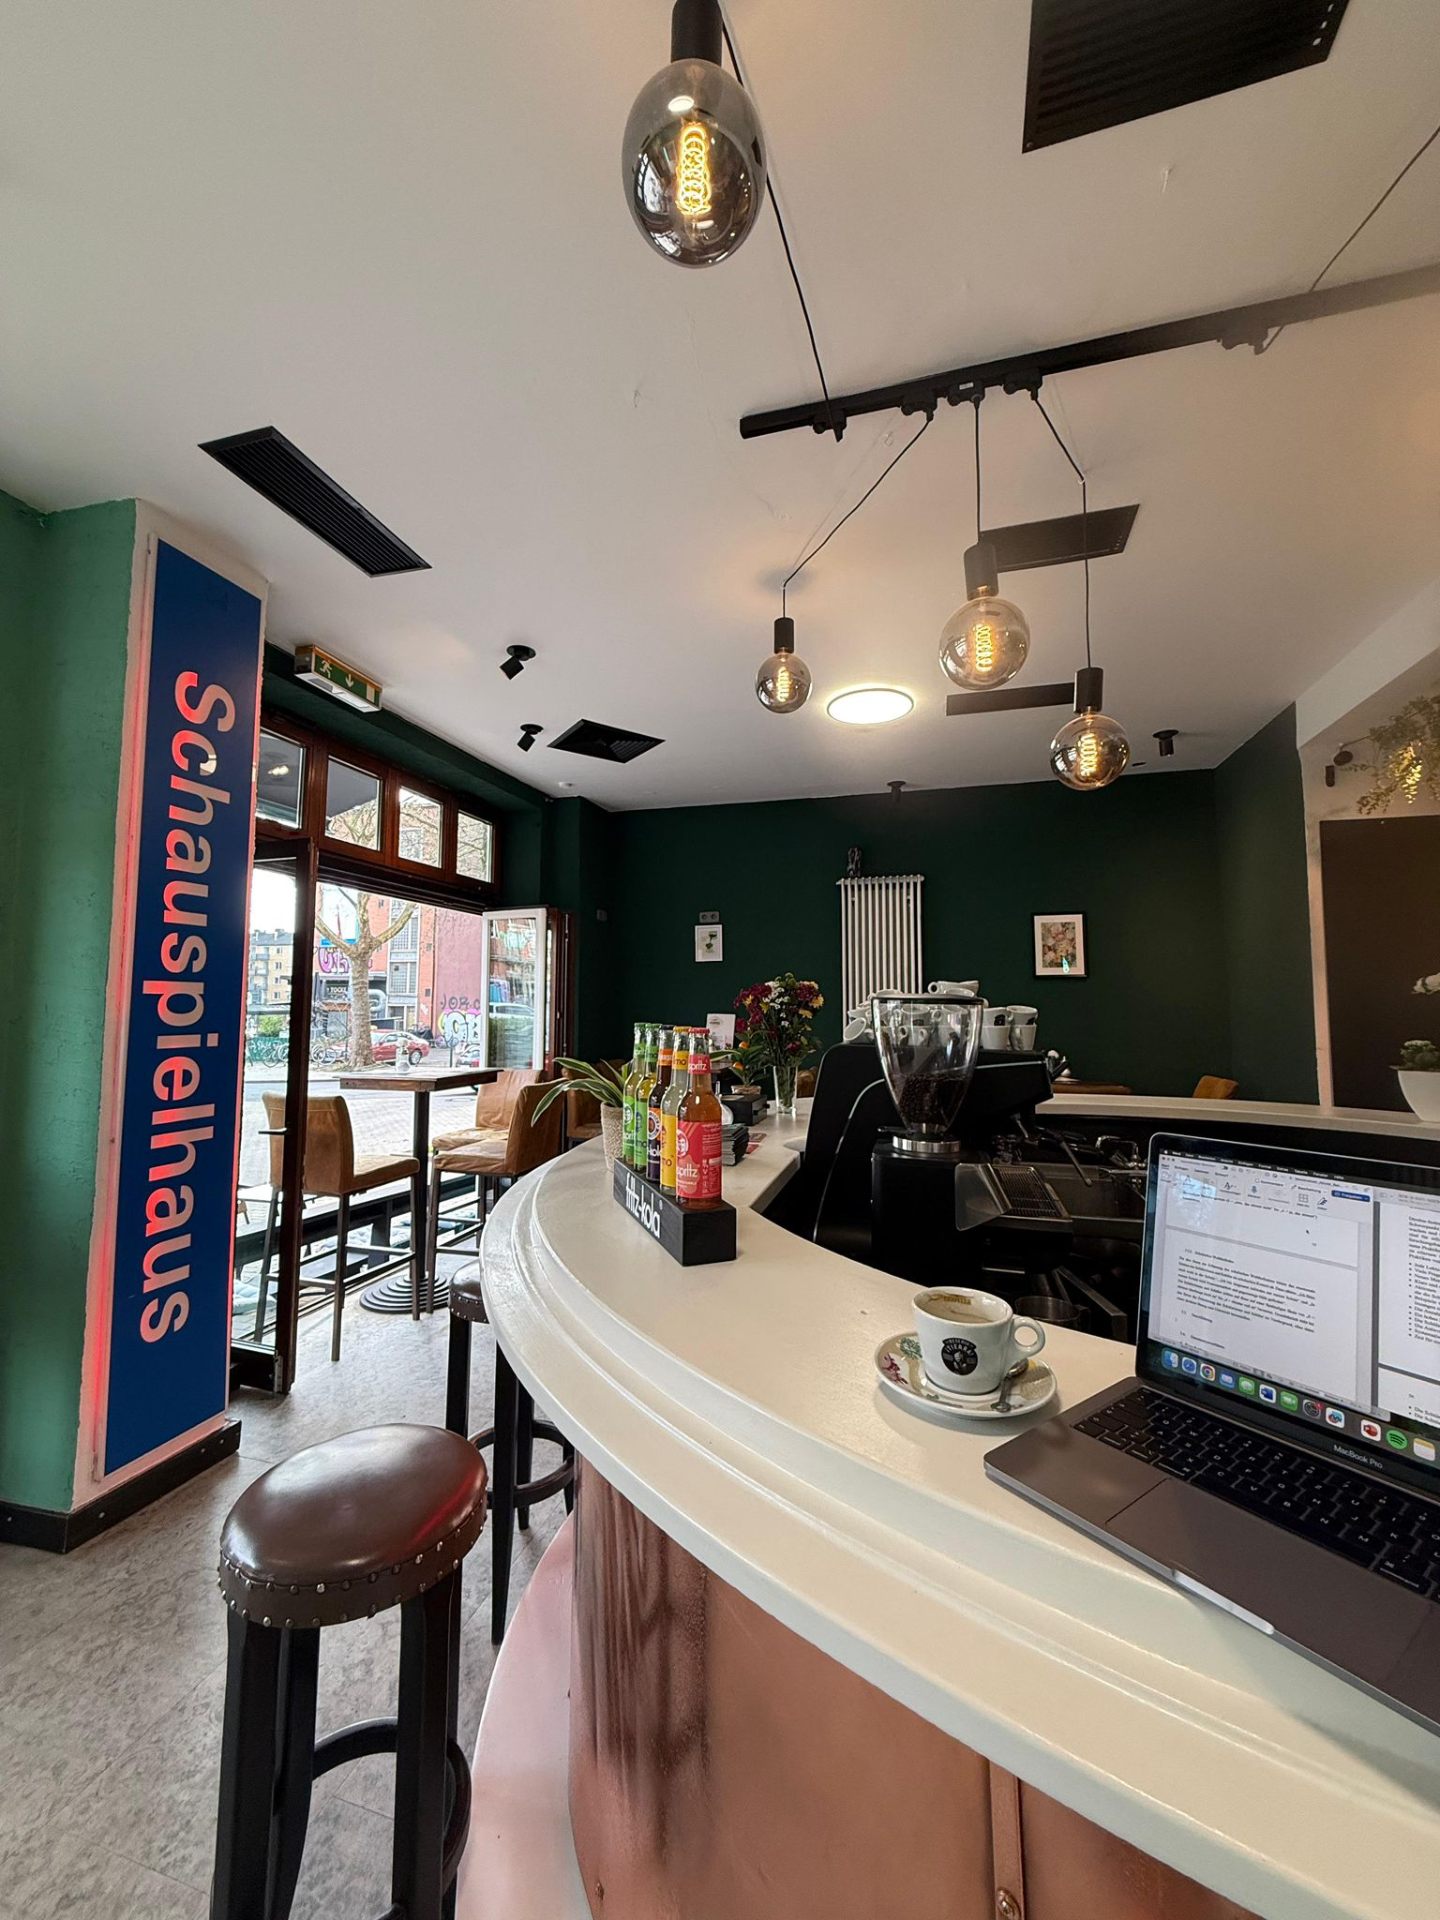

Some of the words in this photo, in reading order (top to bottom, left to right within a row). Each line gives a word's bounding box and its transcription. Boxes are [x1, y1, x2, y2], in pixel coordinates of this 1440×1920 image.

[140, 670, 236, 1344] Schauspielhaus
[625, 1172, 661, 1239] fritz-kola
[1333, 1444, 1369, 1464] MacBook
[1369, 1457, 1383, 1469] Pro
